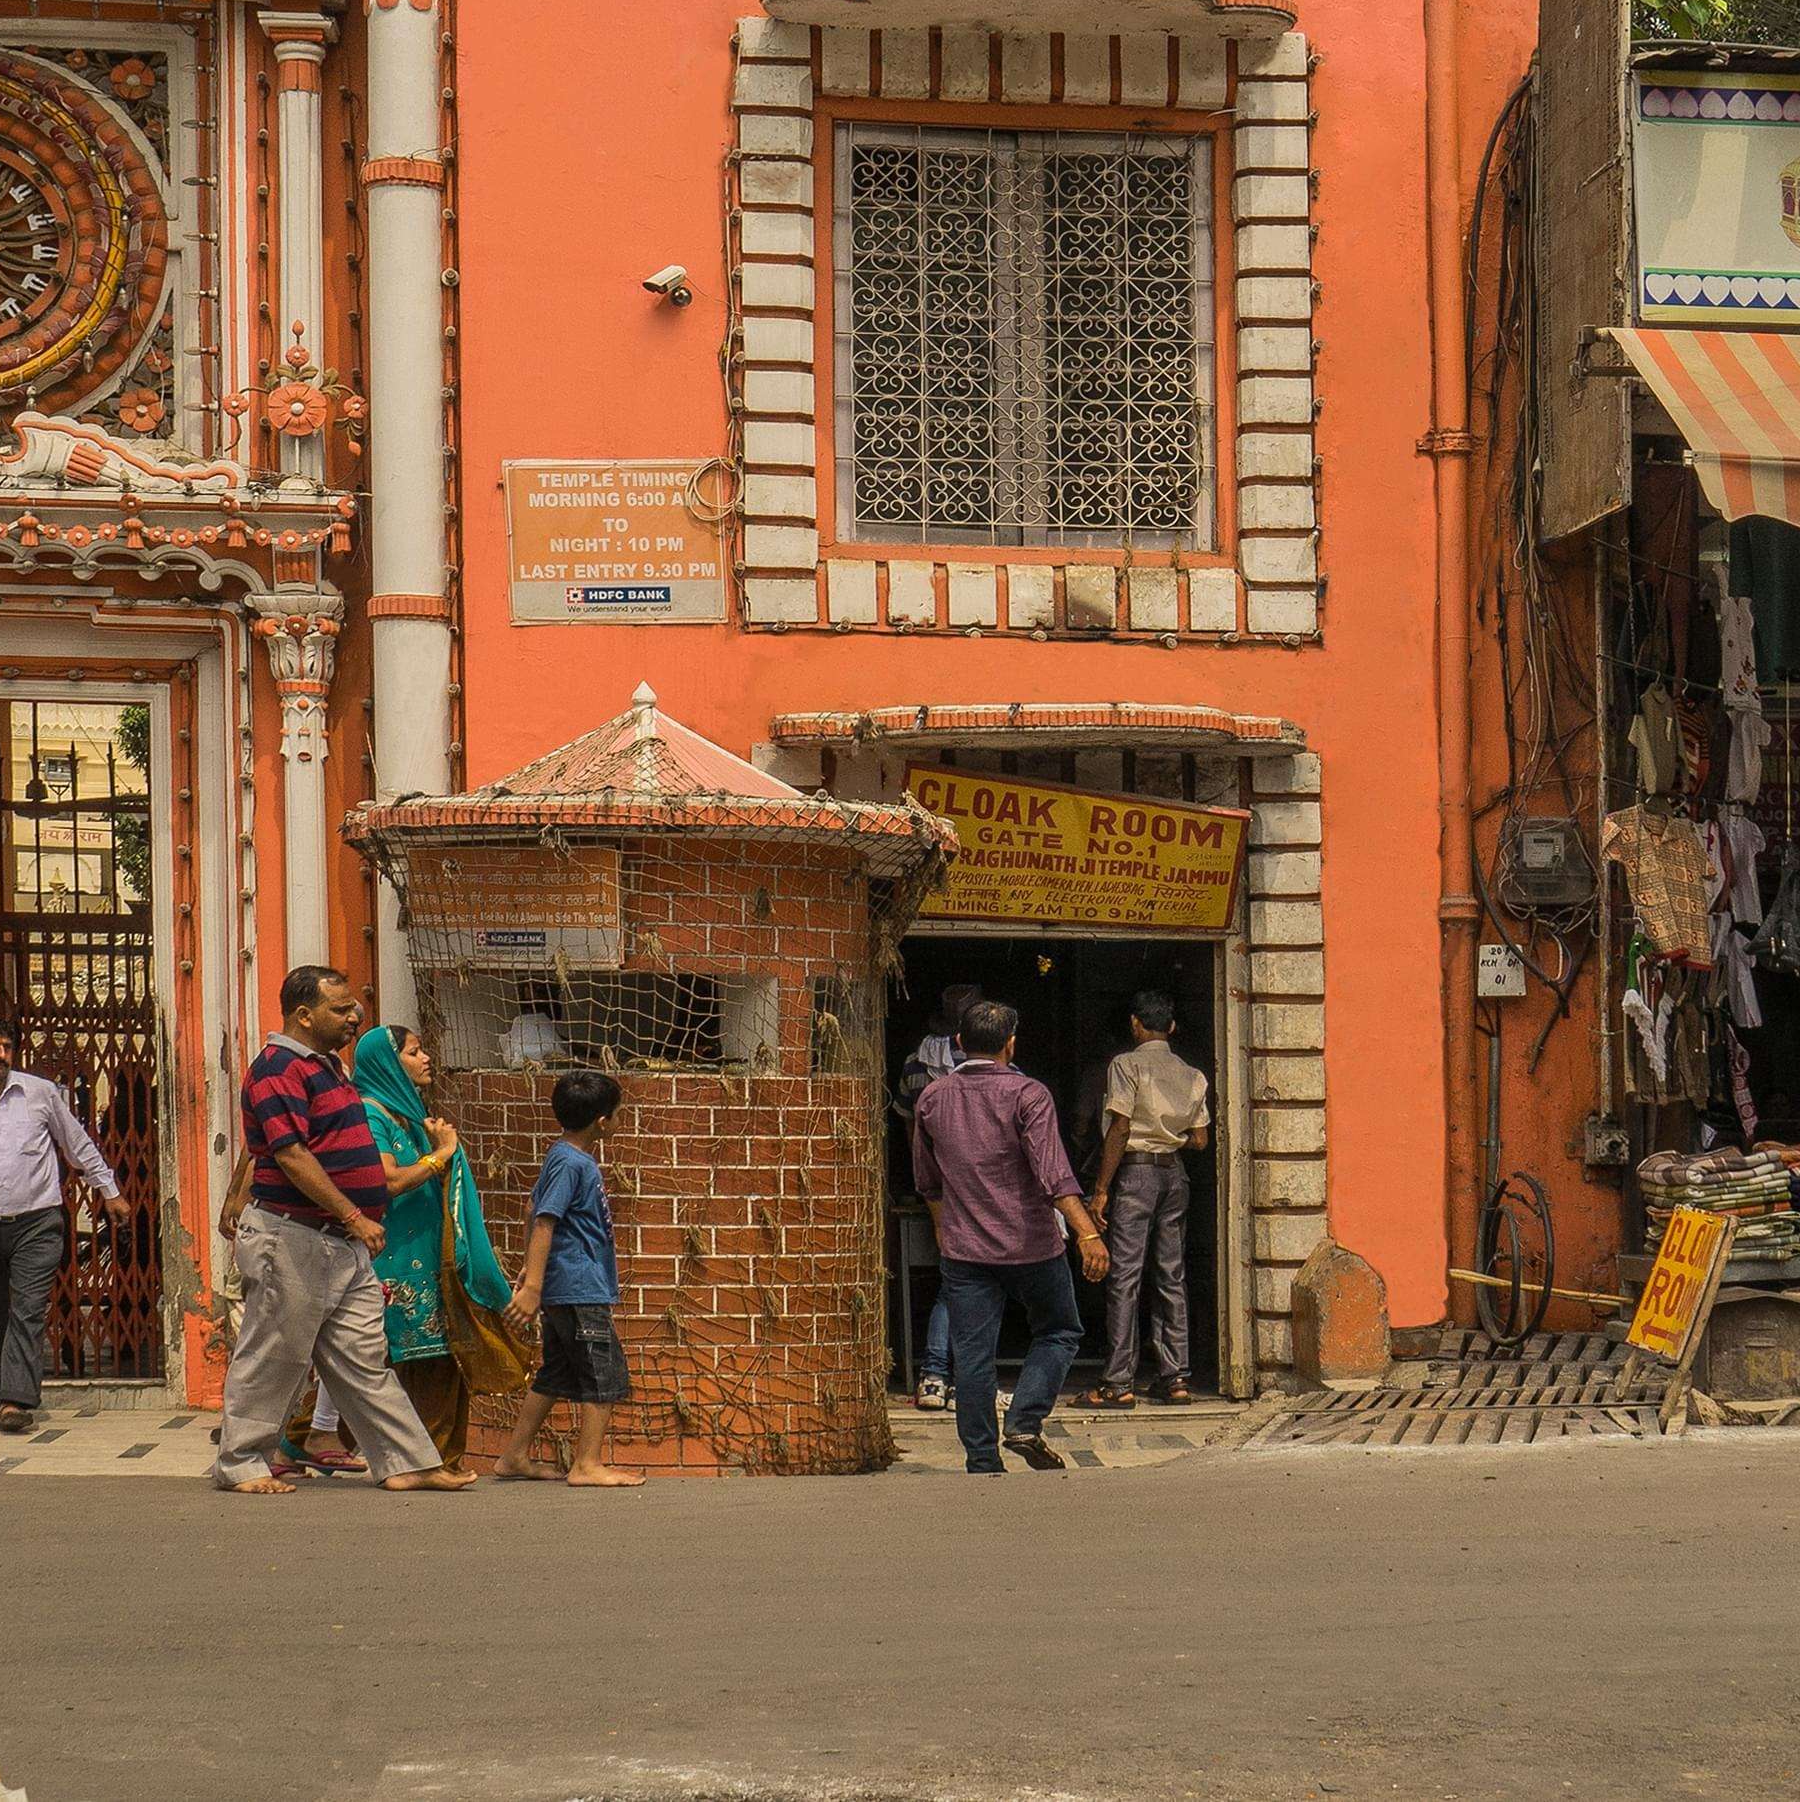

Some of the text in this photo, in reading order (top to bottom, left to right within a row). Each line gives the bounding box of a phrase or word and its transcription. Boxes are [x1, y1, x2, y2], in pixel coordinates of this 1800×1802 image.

[538, 472, 688, 488] TEMPLE TIMING
[528, 492, 621, 508] MORNING
[626, 492, 666, 507] 6:00
[602, 517, 629, 533] TO
[550, 538, 610, 553] NIGHT
[628, 537, 650, 552] 10
[655, 536, 684, 552] PM
[520, 562, 717, 580] LAST ENTRY 9.30 PM
[588, 589, 666, 601] HDFC BANK
[567, 604, 672, 615] We understand your world
[918, 778, 1224, 849] CLOAK ROOM
[79, 831, 104, 843] राम
[977, 826, 1064, 850] GATE
[960, 847, 1078, 874] RAGHUNATH
[1098, 859, 1161, 882] TEMPLE
[1163, 866, 1230, 886] JAMMU
[1044, 891, 1127, 906] ELECTRONIC
[573, 911, 587, 924] The
[1071, 906, 1098, 919] TO
